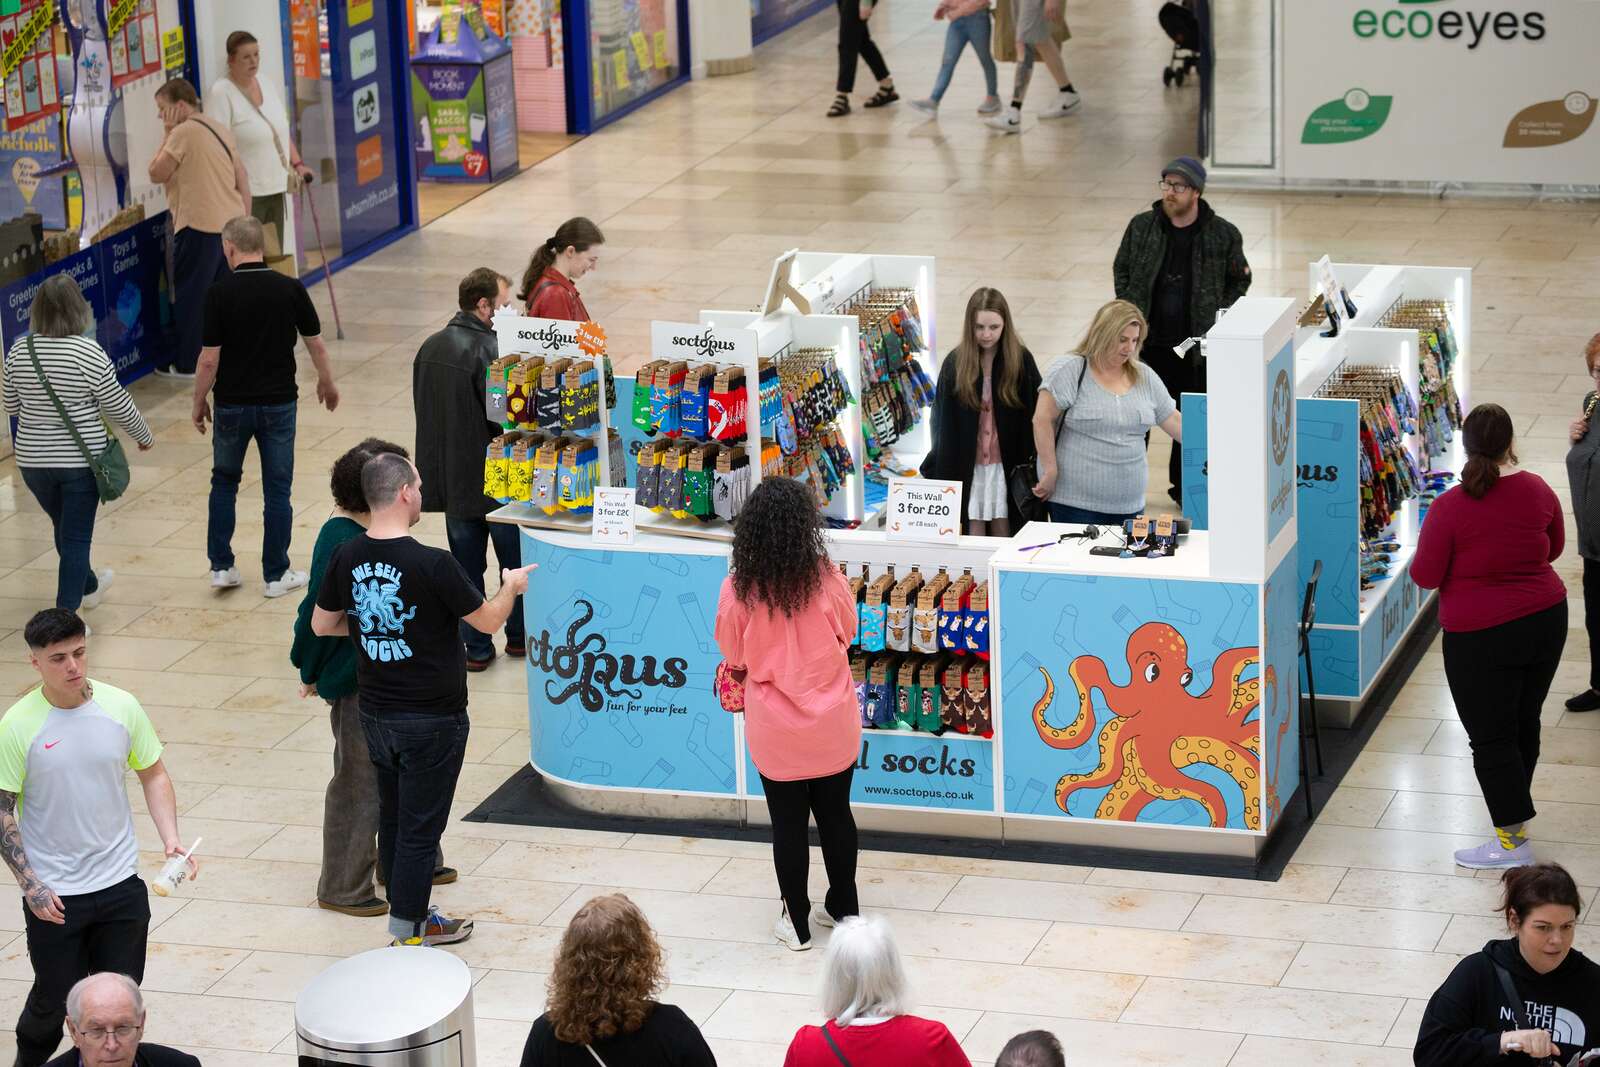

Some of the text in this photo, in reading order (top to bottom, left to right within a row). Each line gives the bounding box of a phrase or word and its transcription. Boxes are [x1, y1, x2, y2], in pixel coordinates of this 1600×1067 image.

[1353, 9, 1546, 49] ecoeyes
[112, 242, 130, 258] Toys
[113, 254, 139, 274] Games
[672, 327, 735, 357] soctopus
[907, 492, 942, 501] This Wall
[604, 508, 615, 516] for
[898, 502, 950, 516] 3 for £20
[352, 562, 402, 586] WE SELL
[606, 700, 687, 717] fun for your feet
[881, 745, 976, 778] socks
[864, 786, 974, 800] www.soctopus.co.uk
[1524, 1000, 1553, 1017] THE
[1500, 1006, 1554, 1029] NTH
